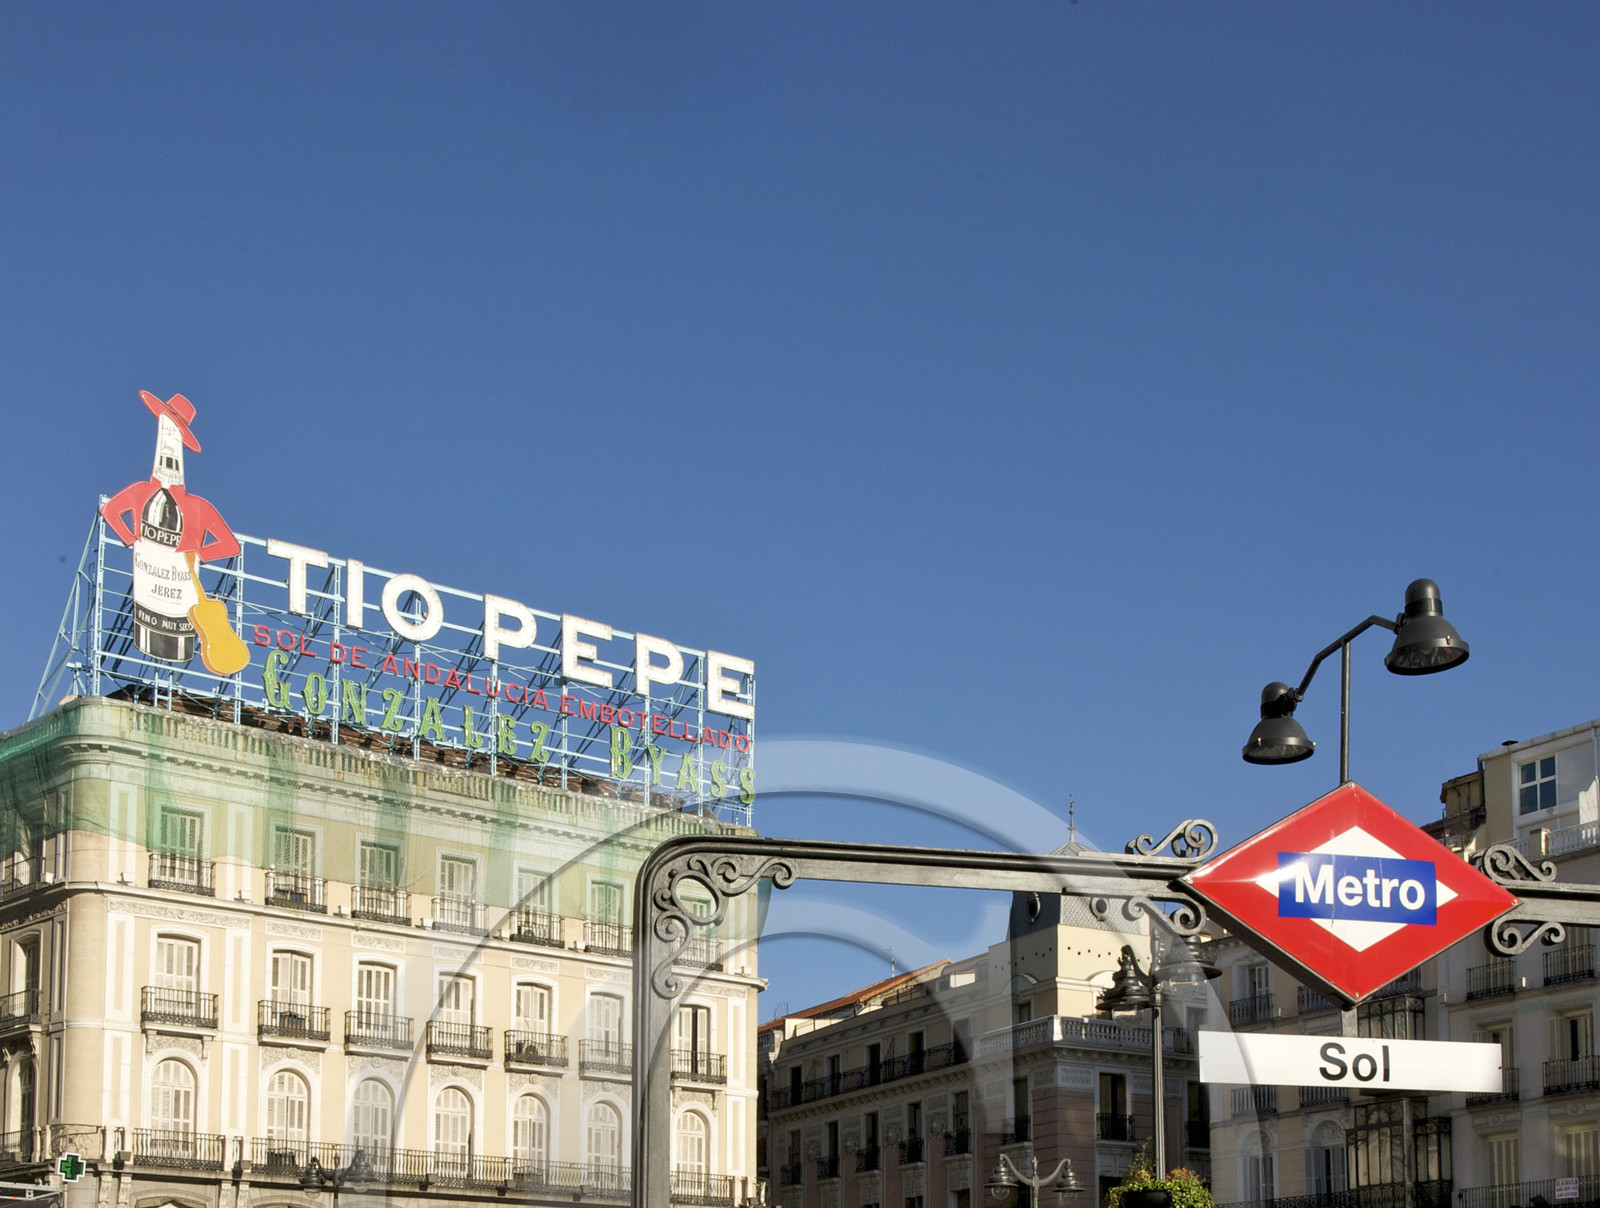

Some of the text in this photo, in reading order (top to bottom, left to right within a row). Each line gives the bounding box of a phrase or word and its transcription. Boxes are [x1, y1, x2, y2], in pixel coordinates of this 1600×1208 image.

[135, 552, 170, 580] GONZALEZ
[151, 584, 182, 599] JEREZ
[138, 609, 157, 625] FINO
[162, 619, 177, 631] MUY
[267, 538, 755, 720] TIO PEPE
[254, 624, 750, 753] SOL DE ANDALUCIA EMBOTELLADO
[262, 650, 756, 804] GONZALEZ BYASS
[1294, 862, 1425, 911] Metro
[1319, 1042, 1391, 1082] Sol
